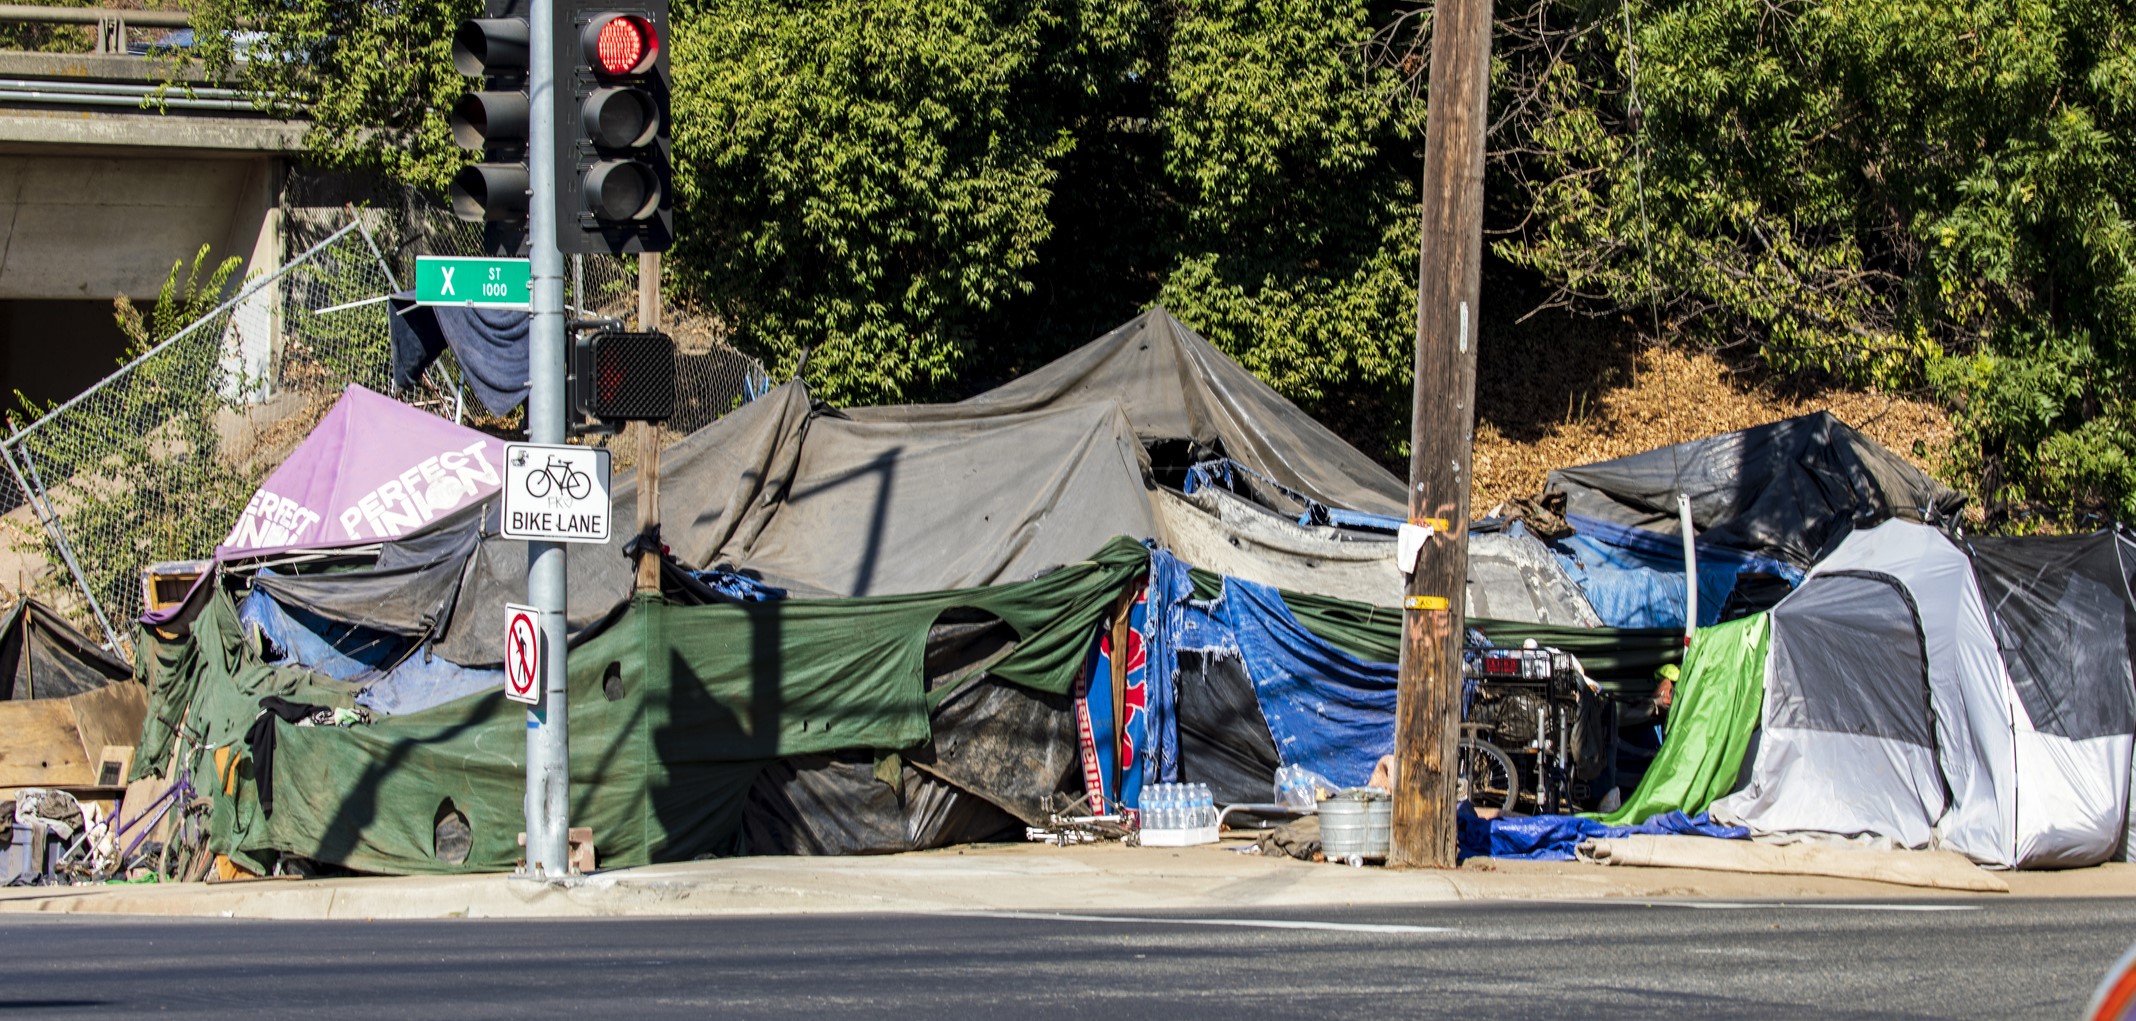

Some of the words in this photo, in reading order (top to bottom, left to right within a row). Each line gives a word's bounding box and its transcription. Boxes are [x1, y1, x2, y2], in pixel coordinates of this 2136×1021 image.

[441, 266, 456, 296] X
[488, 267, 501, 280] ST
[482, 283, 508, 297] 1000
[339, 440, 487, 535] PERFECT
[512, 511, 552, 531] BIKE
[558, 513, 602, 534] LANE
